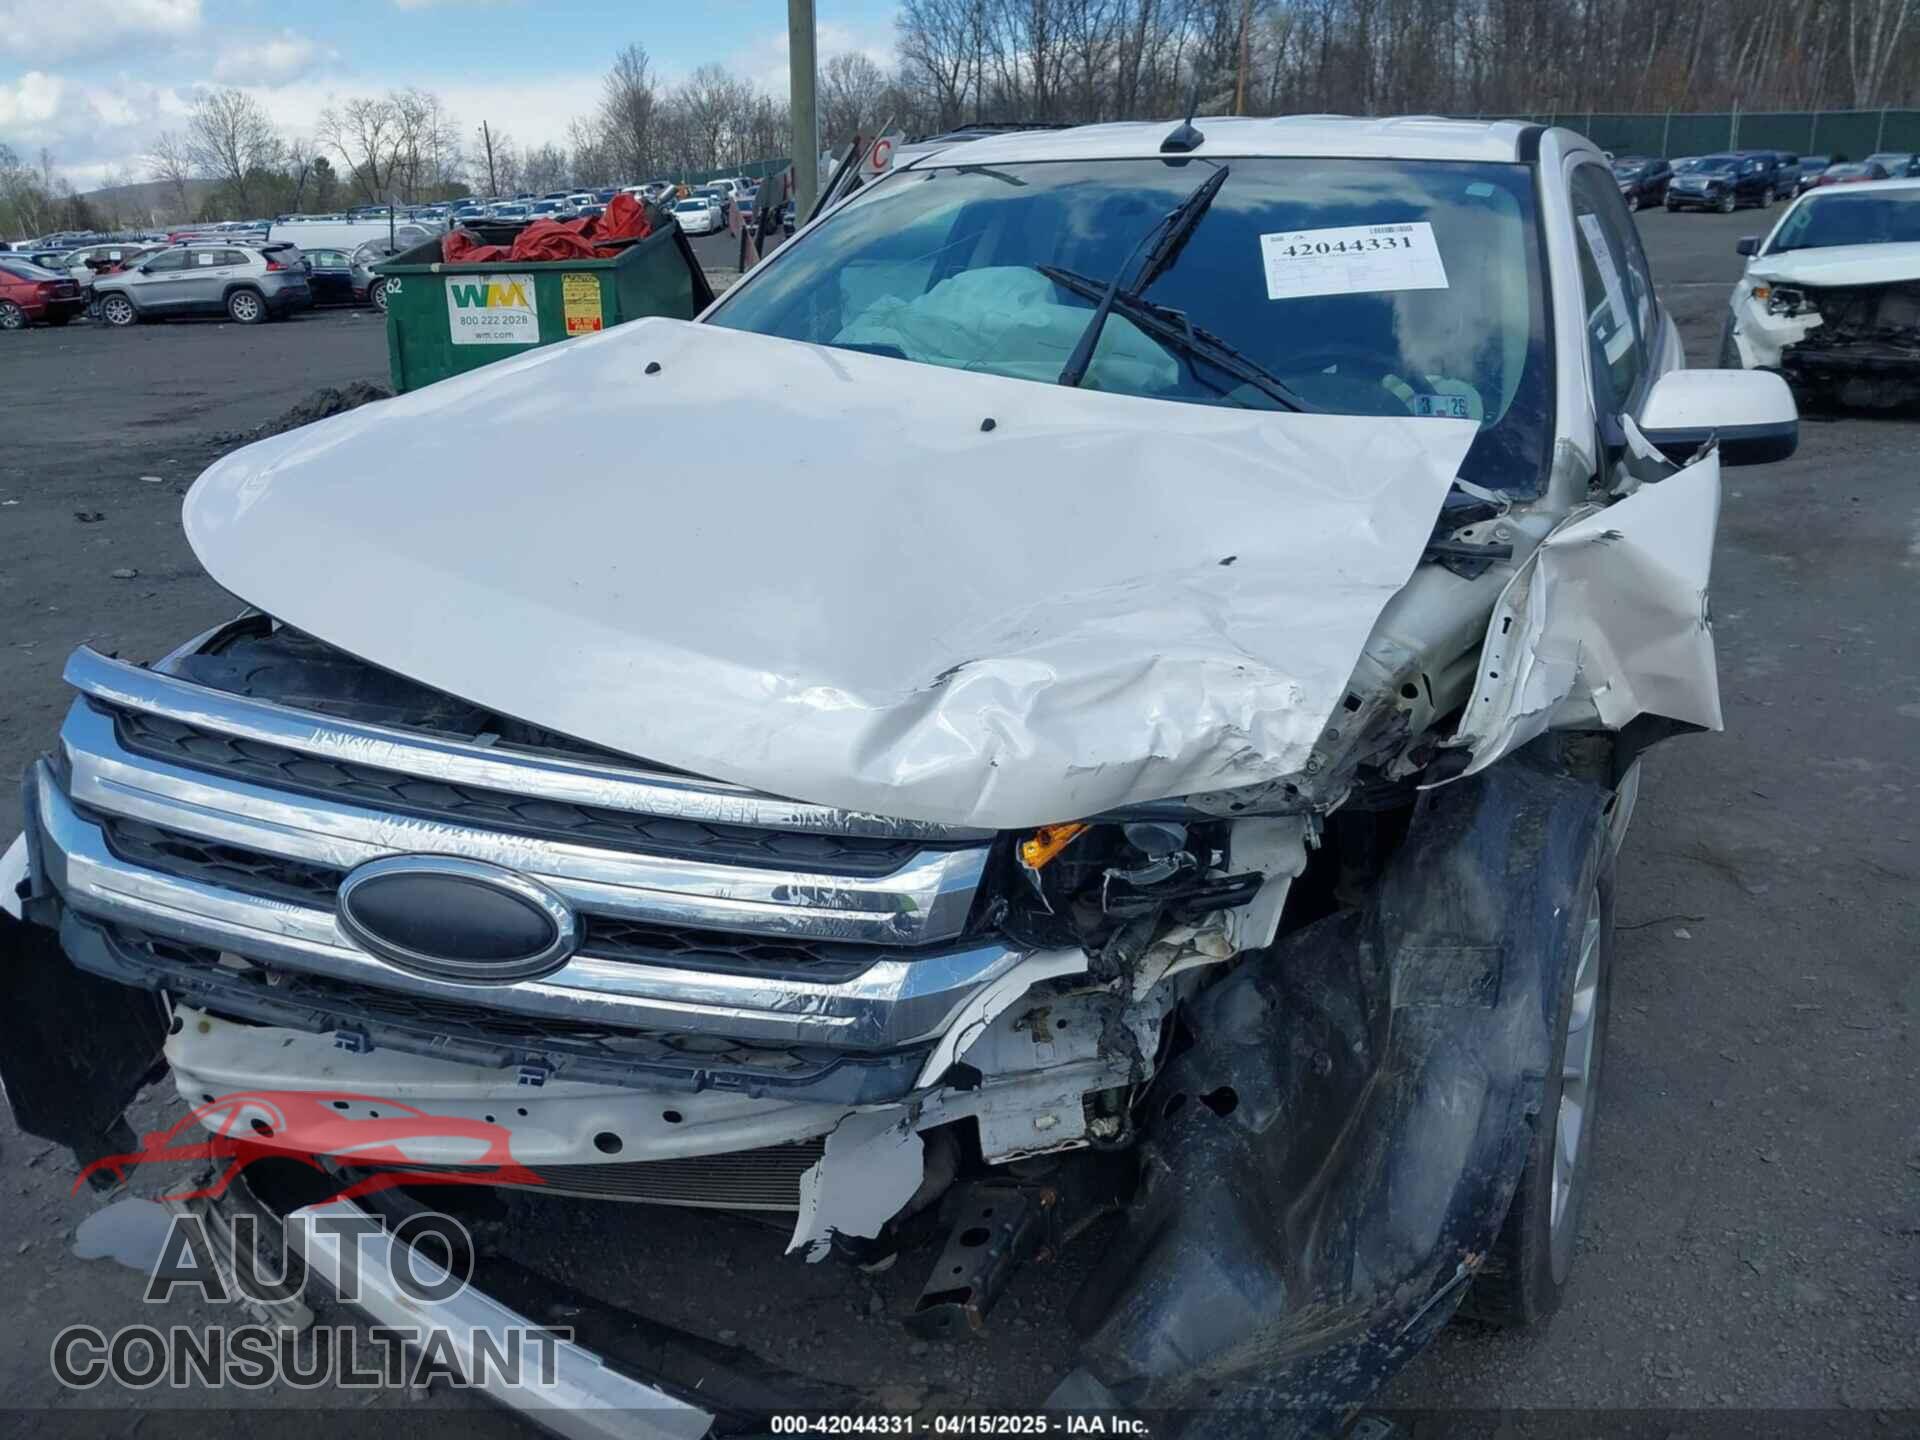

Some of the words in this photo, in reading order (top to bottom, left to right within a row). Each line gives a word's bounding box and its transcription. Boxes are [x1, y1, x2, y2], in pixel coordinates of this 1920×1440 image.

[872, 140, 891, 169] C
[1282, 236, 1413, 257] 42044331
[386, 277, 403, 294] 62
[451, 283, 529, 309] WM
[460, 316, 479, 326] 800
[481, 315, 500, 325] 222
